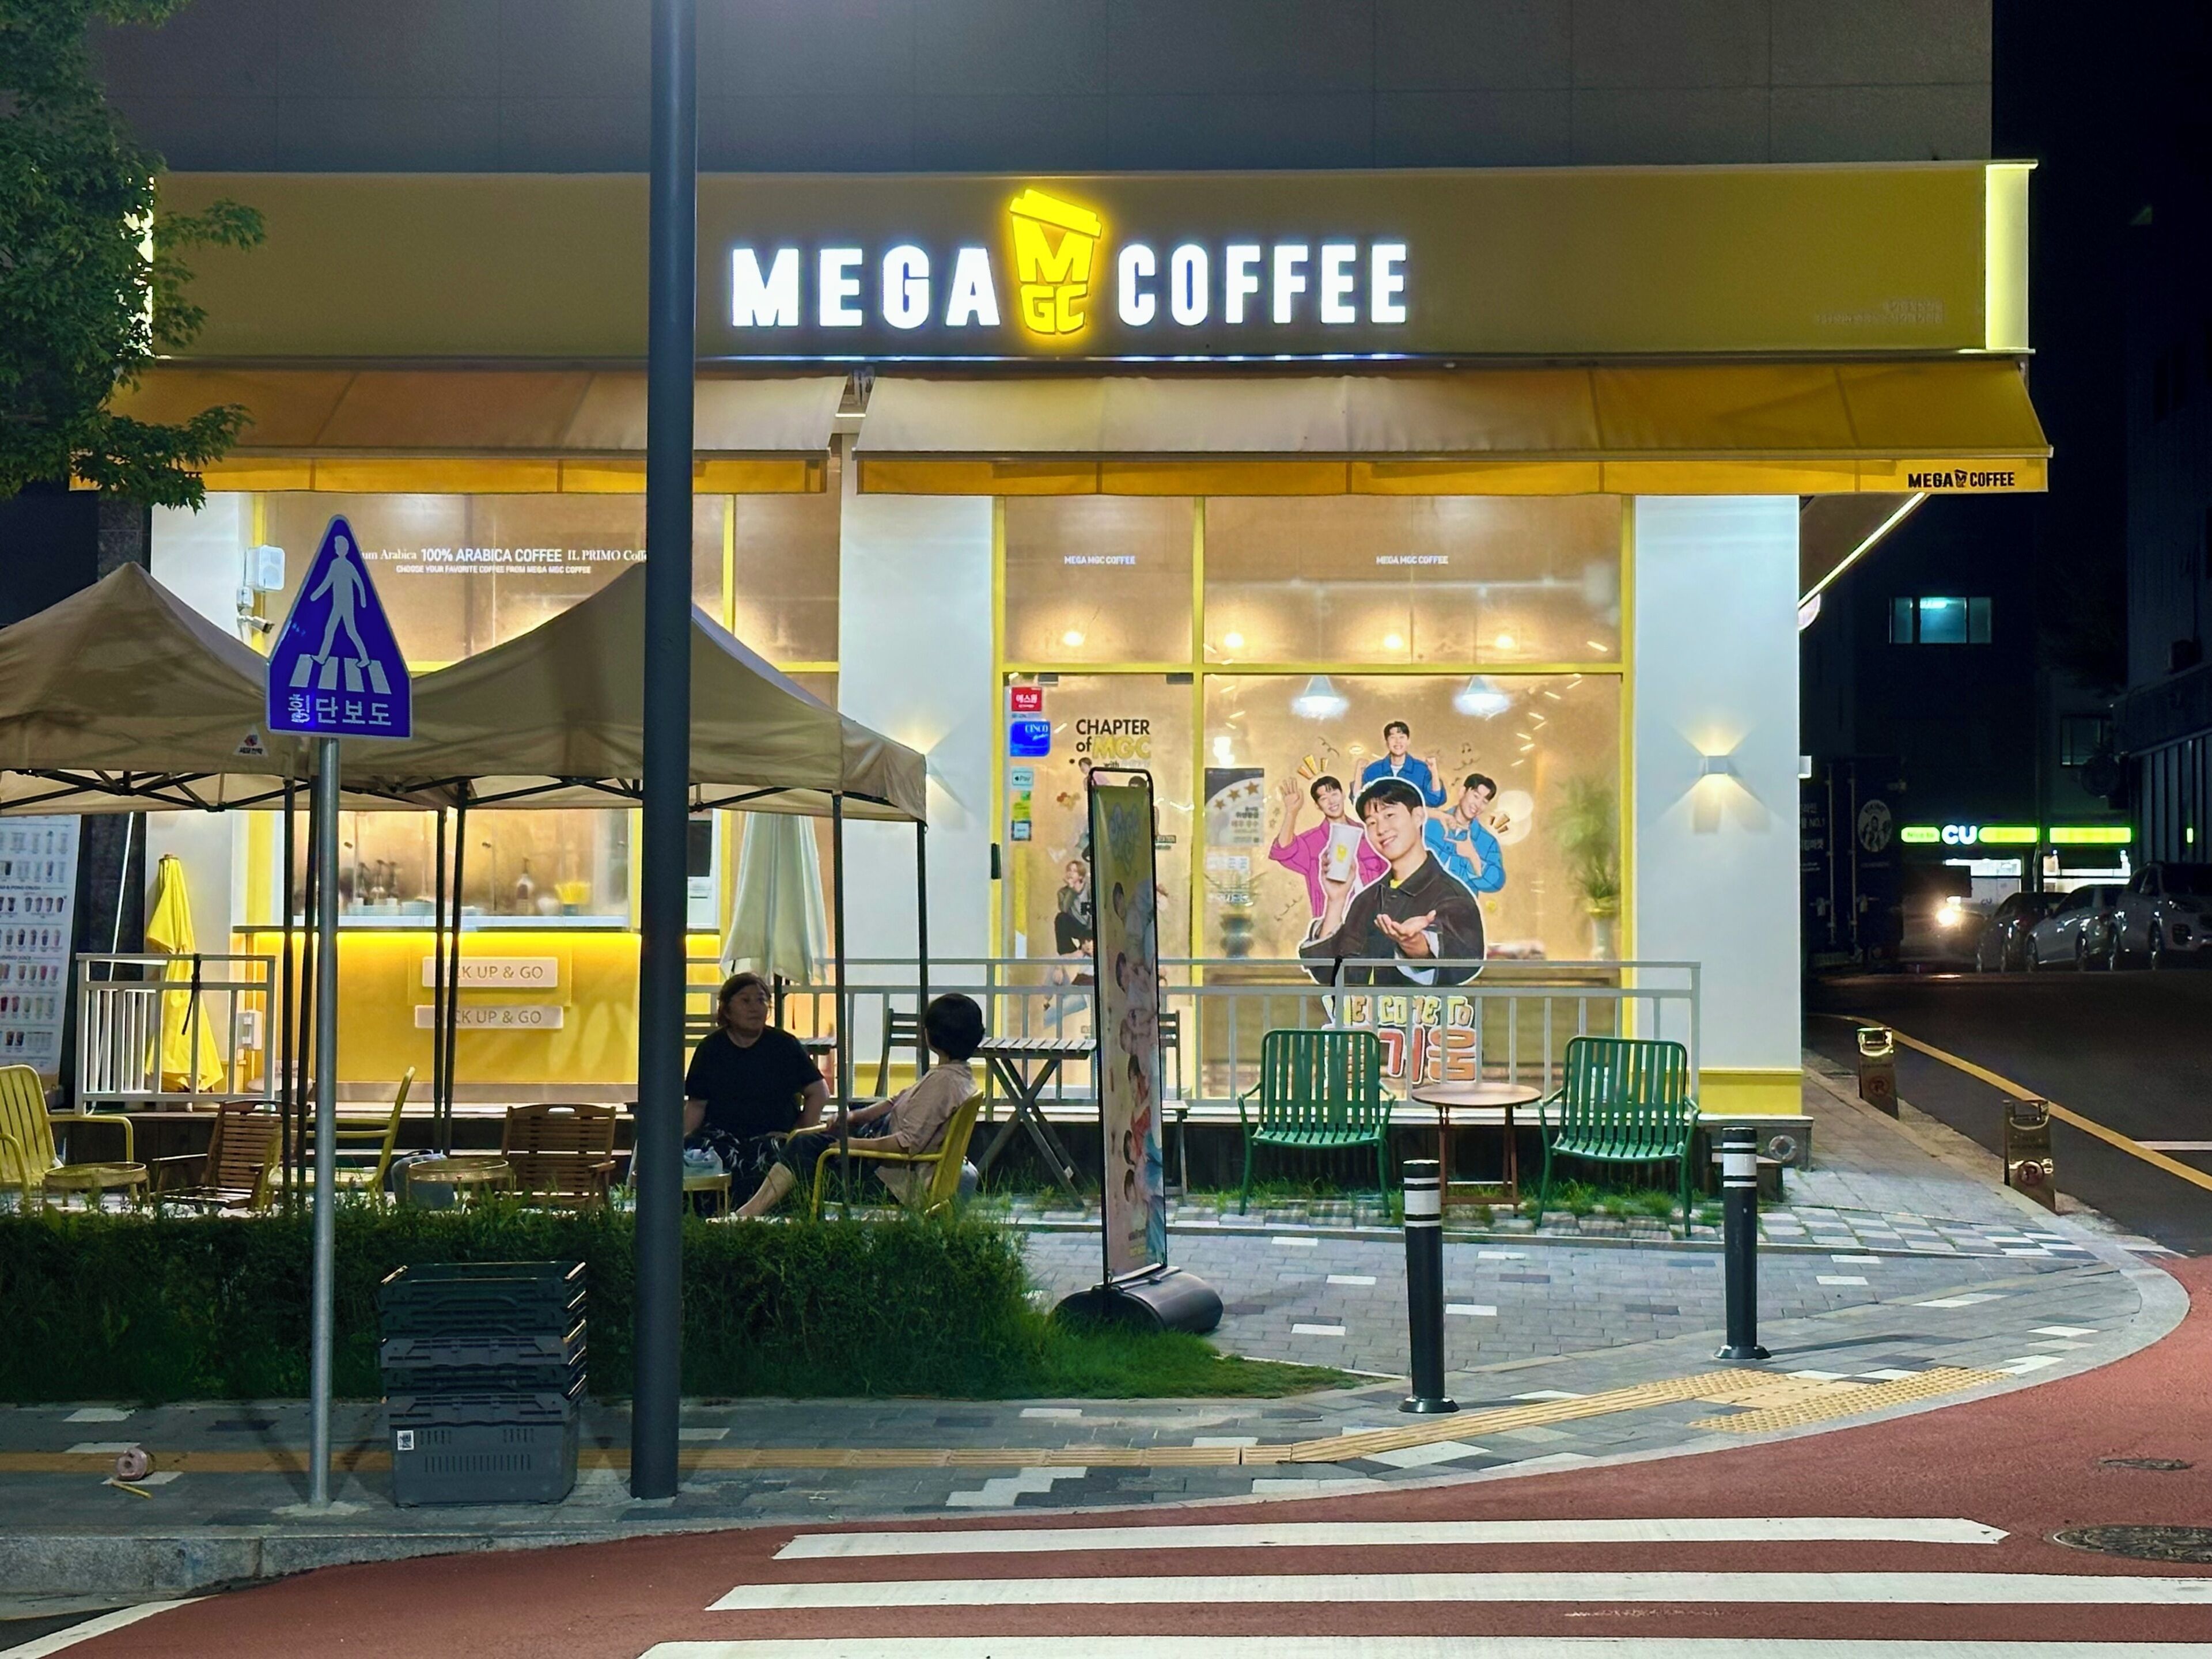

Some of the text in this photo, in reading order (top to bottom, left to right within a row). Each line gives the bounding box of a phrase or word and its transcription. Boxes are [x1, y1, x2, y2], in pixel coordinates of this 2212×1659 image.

[732, 244, 1001, 329] MEGA
[1118, 244, 1407, 326] COFFEE
[1908, 473, 1953, 488] MEGA
[1969, 472, 2015, 487] COFFEE
[380, 548, 417, 560] Arabica
[421, 548, 453, 561] 100%
[456, 548, 512, 562] ARABICA
[515, 548, 562, 562] COFFEE
[582, 550, 620, 561] PRIMO
[1064, 555, 1086, 565] MEGA
[1105, 555, 1136, 565] COFFEE
[1376, 555, 1399, 565] MEGA
[1418, 555, 1449, 565] COFFEE
[396, 565, 424, 573] CHOOSE
[425, 565, 444, 573] YOUR
[445, 565, 477, 573] FAVORITE
[478, 565, 505, 574] COFFEE
[505, 565, 525, 574] FROM
[527, 565, 547, 574] MEGA
[565, 565, 592, 574] COFFEE
[288, 694, 392, 726] 횡단보도
[1075, 718, 1150, 735] CHAPTER
[1075, 735, 1152, 759] of MGC
[1941, 824, 1978, 844] CU
[478, 966, 498, 978] UP
[503, 965, 514, 979] &
[520, 966, 543, 979] GO
[476, 1011, 497, 1024] UP
[502, 1010, 513, 1024] &
[518, 1011, 541, 1024] GO
